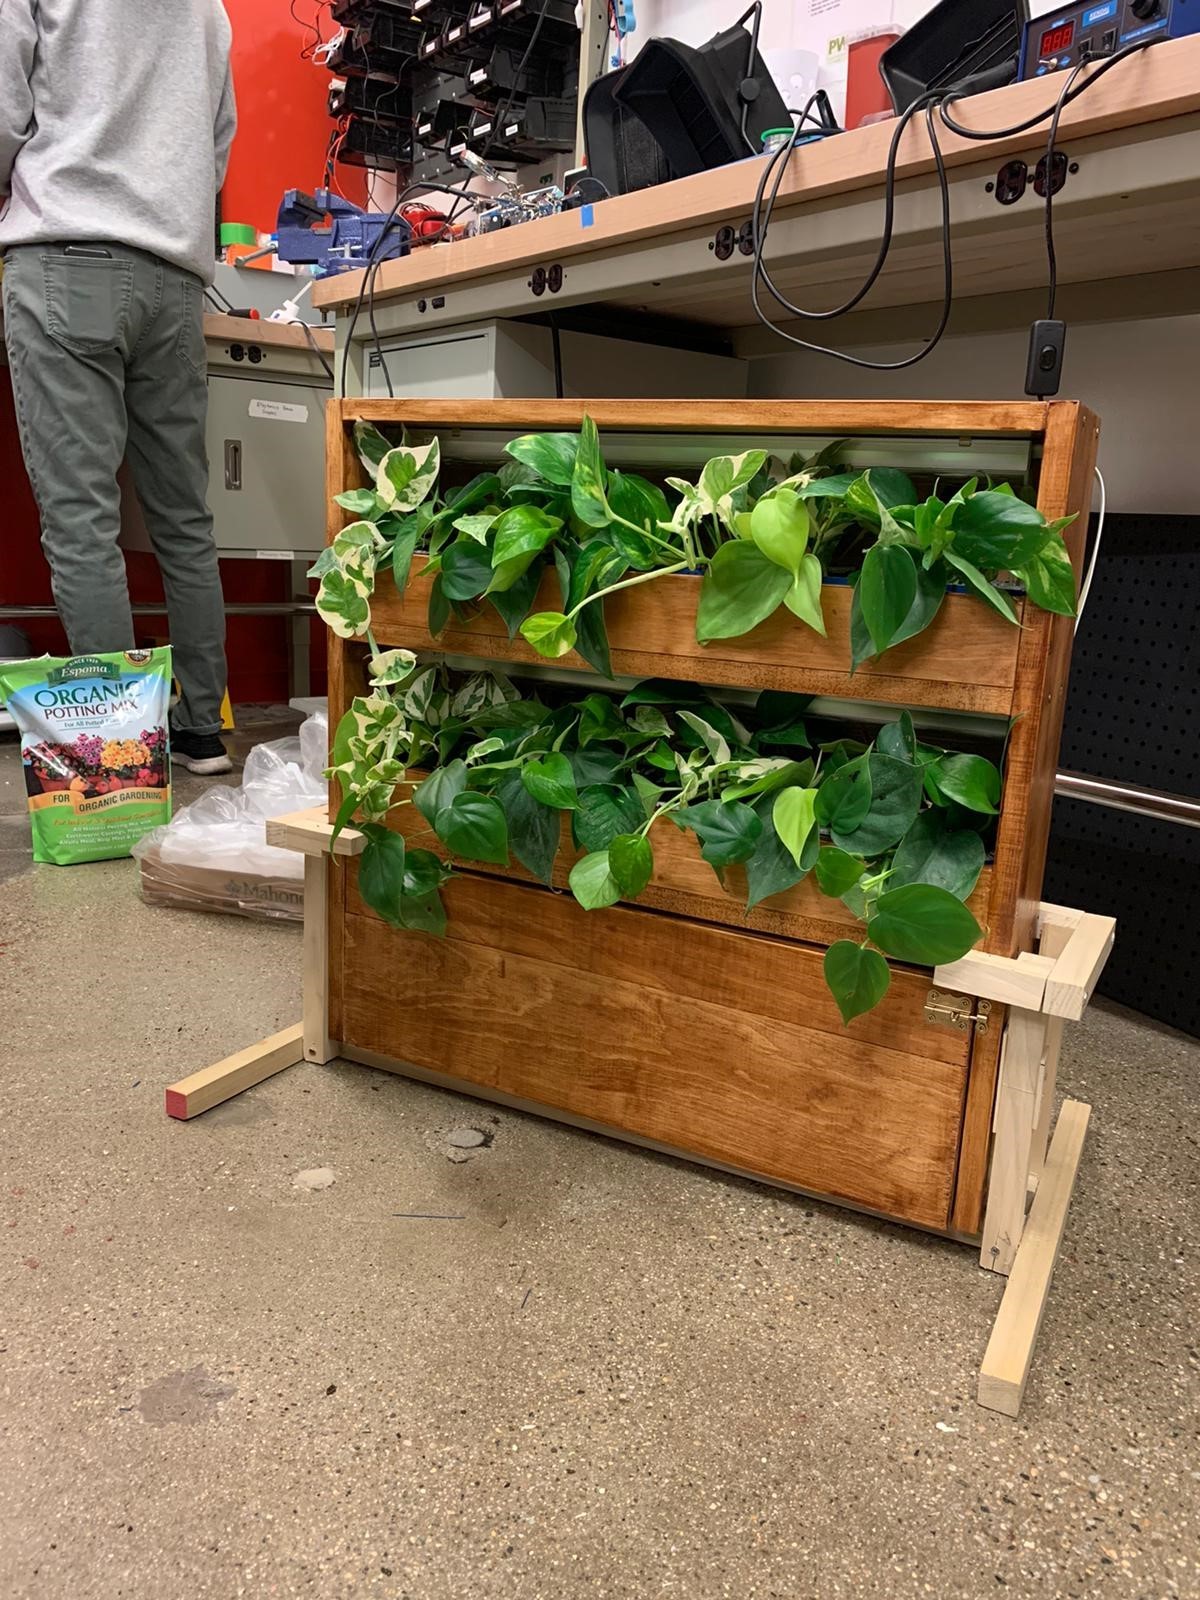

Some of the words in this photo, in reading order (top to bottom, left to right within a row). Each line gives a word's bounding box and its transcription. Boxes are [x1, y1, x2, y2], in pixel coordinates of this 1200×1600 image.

[829, 36, 845, 54] PV
[61, 666, 108, 677] Espoma
[34, 680, 143, 707] ORGANIC
[44, 704, 107, 720] POTTING
[53, 794, 70, 803] FOR
[79, 795, 118, 812] ORGANIC
[119, 791, 162, 801] GARDENING
